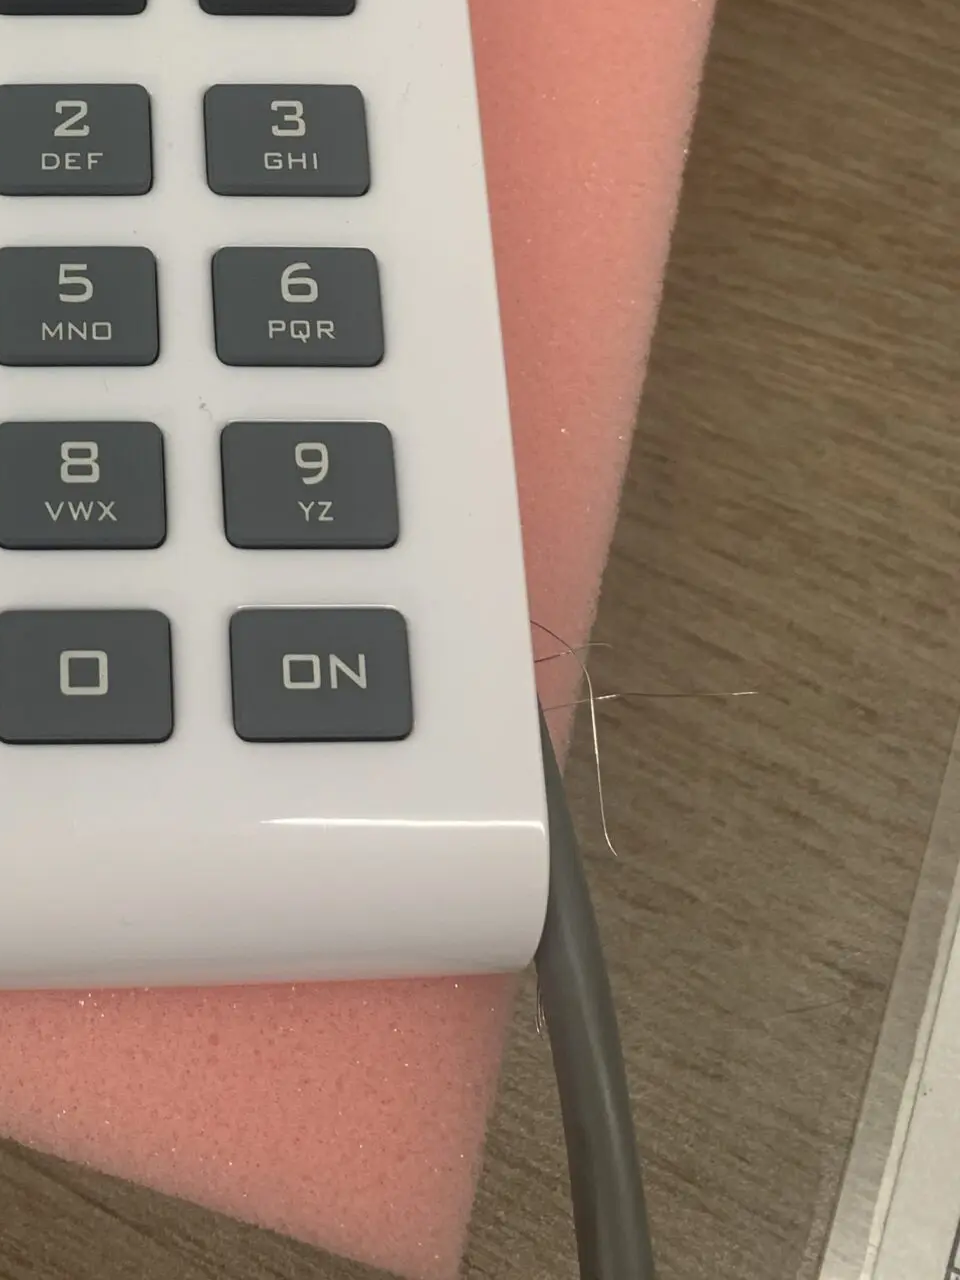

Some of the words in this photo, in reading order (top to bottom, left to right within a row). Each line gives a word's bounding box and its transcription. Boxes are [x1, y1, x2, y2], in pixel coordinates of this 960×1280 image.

[53, 100, 90, 137] 2
[270, 100, 306, 137] 3
[41, 152, 104, 170] DEF
[264, 152, 318, 170] GHI
[58, 263, 94, 303] 5
[280, 262, 319, 303] 6
[41, 321, 112, 341] MNO
[268, 319, 335, 343] PQR
[60, 441, 100, 484] 8
[294, 442, 329, 485] 9
[44, 501, 118, 521] VWX
[298, 501, 334, 522] YZ
[282, 653, 367, 690] ON
